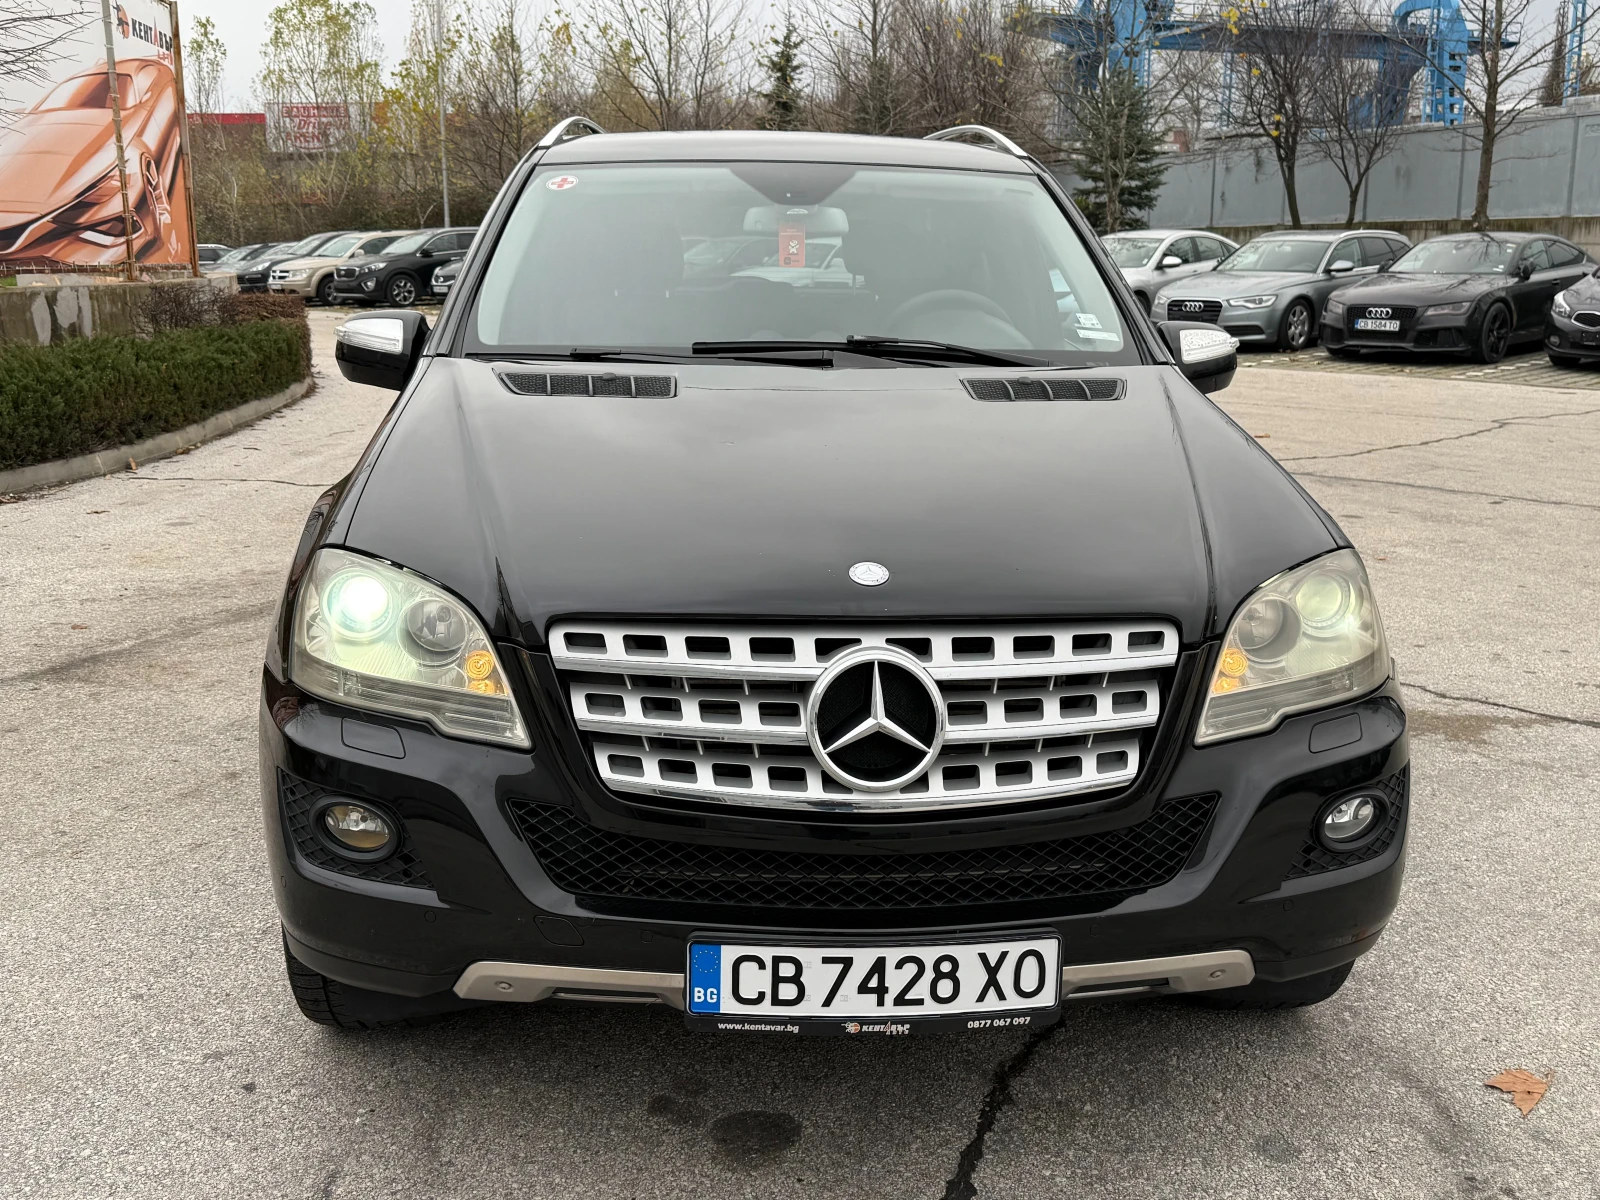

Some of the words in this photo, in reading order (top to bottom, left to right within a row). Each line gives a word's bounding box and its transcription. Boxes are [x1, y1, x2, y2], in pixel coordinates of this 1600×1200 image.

[731, 954, 806, 1007] CB
[821, 953, 960, 1008] 7428
[975, 948, 1046, 1003] XO
[694, 987, 718, 1003] BG
[717, 1022, 799, 1034] www.kentavar.bg
[967, 1019, 991, 1029] 0877
[993, 1018, 1011, 1027] 067
[1012, 1016, 1031, 1026] 097
